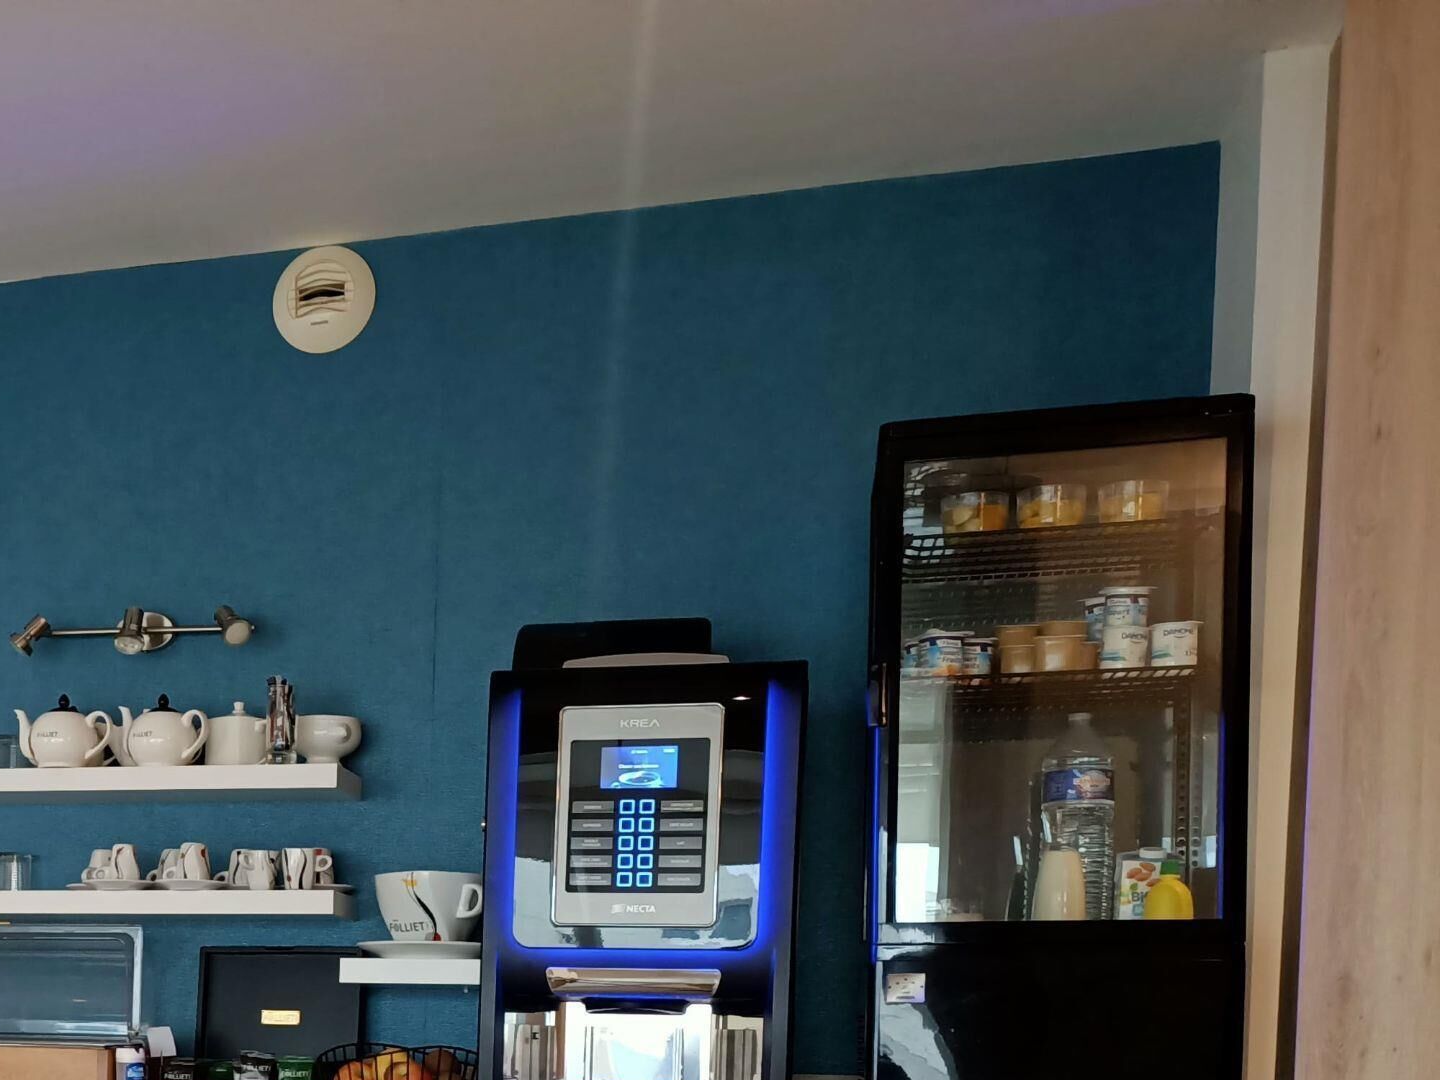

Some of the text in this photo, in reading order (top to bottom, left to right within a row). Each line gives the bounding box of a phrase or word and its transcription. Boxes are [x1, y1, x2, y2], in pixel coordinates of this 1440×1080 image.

[620, 719, 660, 728] KREA
[626, 905, 656, 913] NECTA
[390, 921, 425, 932] FOLLIET
